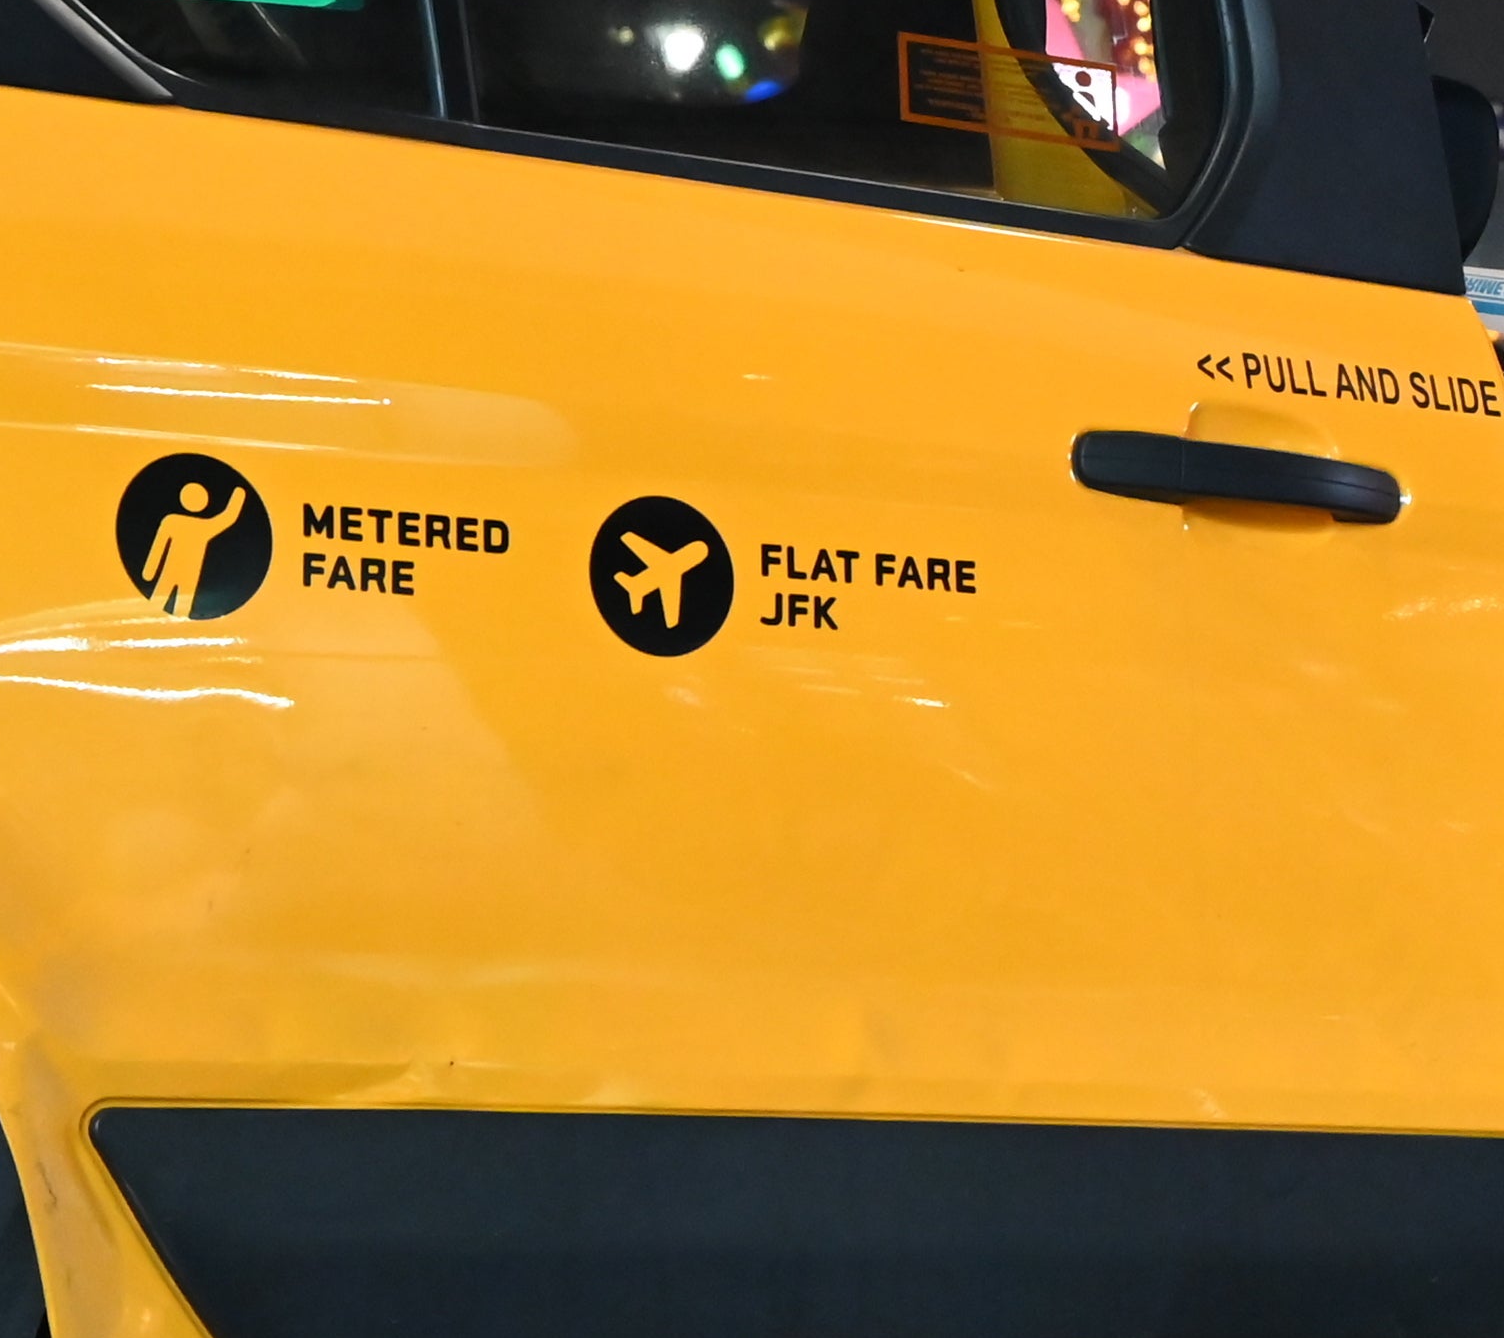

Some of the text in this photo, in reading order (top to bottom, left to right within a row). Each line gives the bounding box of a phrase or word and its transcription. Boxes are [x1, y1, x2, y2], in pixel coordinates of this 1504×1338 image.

[1240, 352, 1331, 399] PULL
[1336, 362, 1406, 407] AND
[1410, 369, 1501, 418] SLIDE
[302, 503, 511, 557] METERED
[302, 552, 416, 597] FARE
[759, 542, 979, 596] FLAT FARE
[759, 590, 840, 632] JFK
